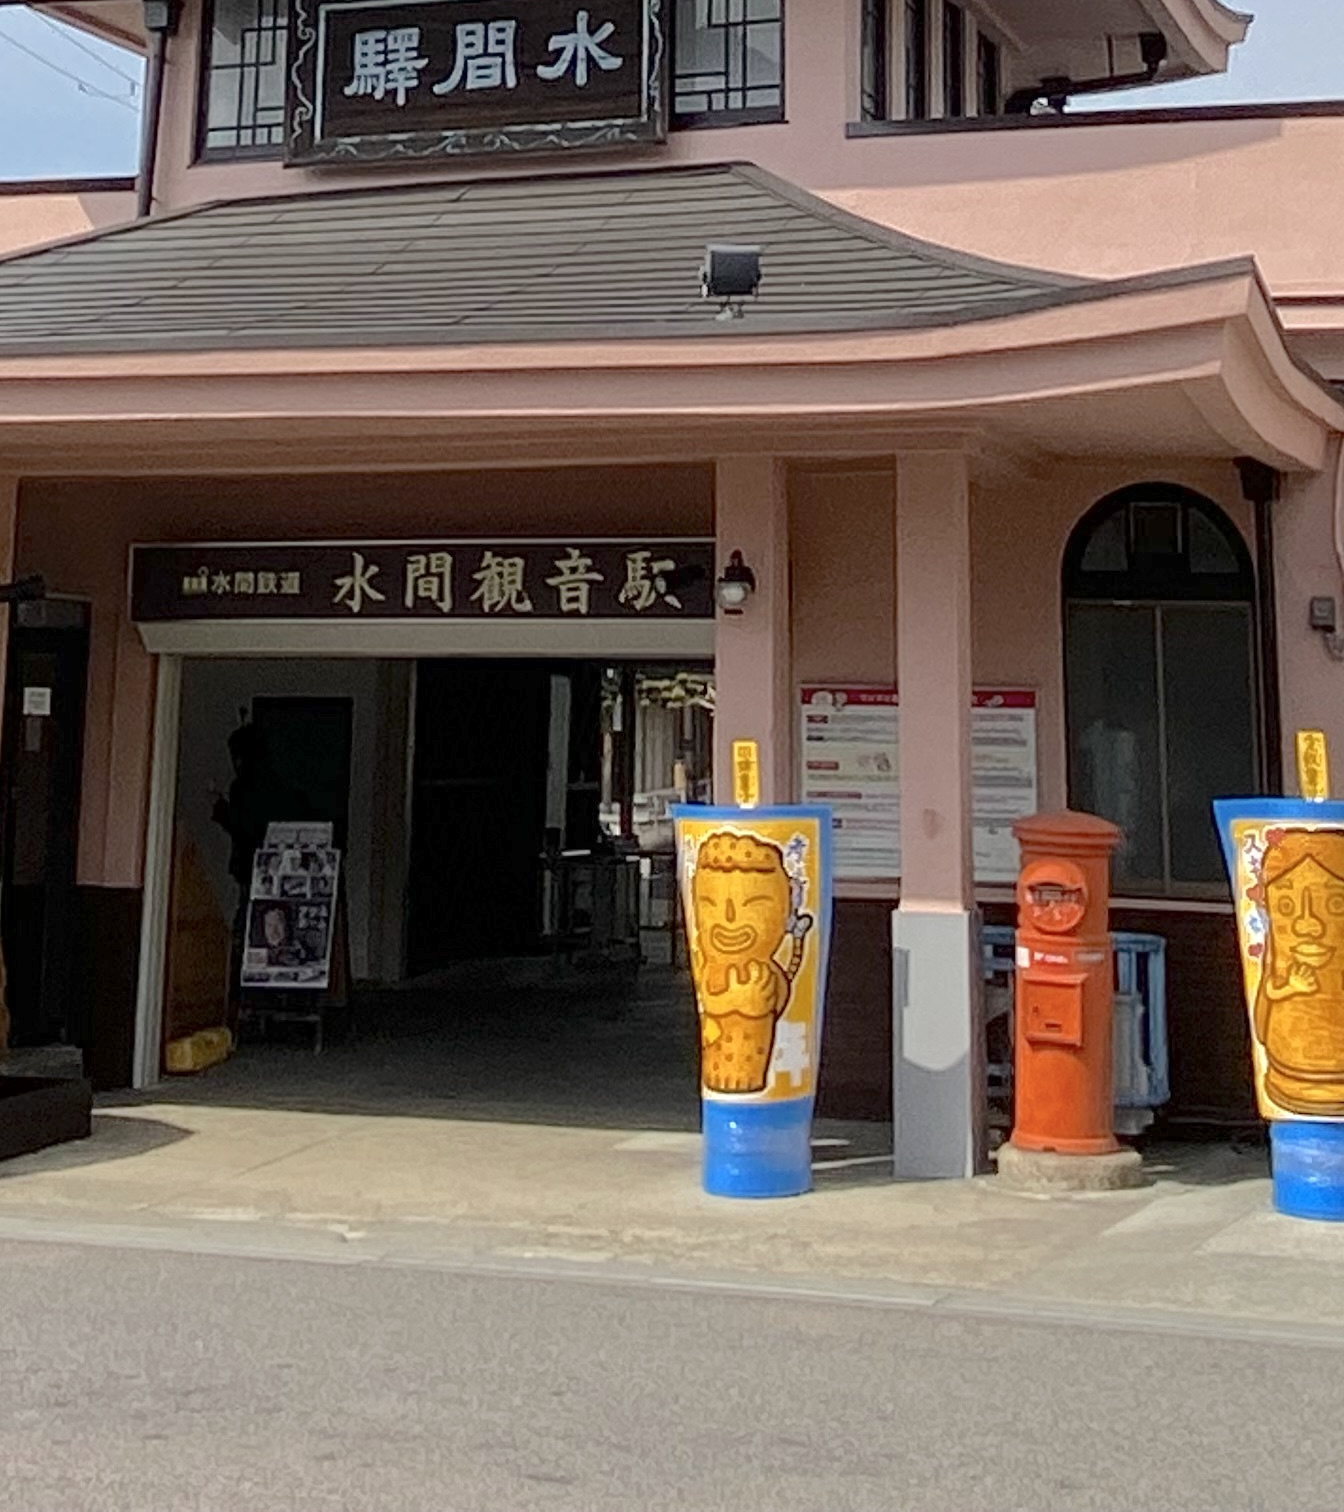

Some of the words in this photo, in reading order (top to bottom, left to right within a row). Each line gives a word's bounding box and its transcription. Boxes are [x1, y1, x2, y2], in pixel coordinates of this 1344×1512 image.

[333, 548, 683, 614] 水間観音駅
